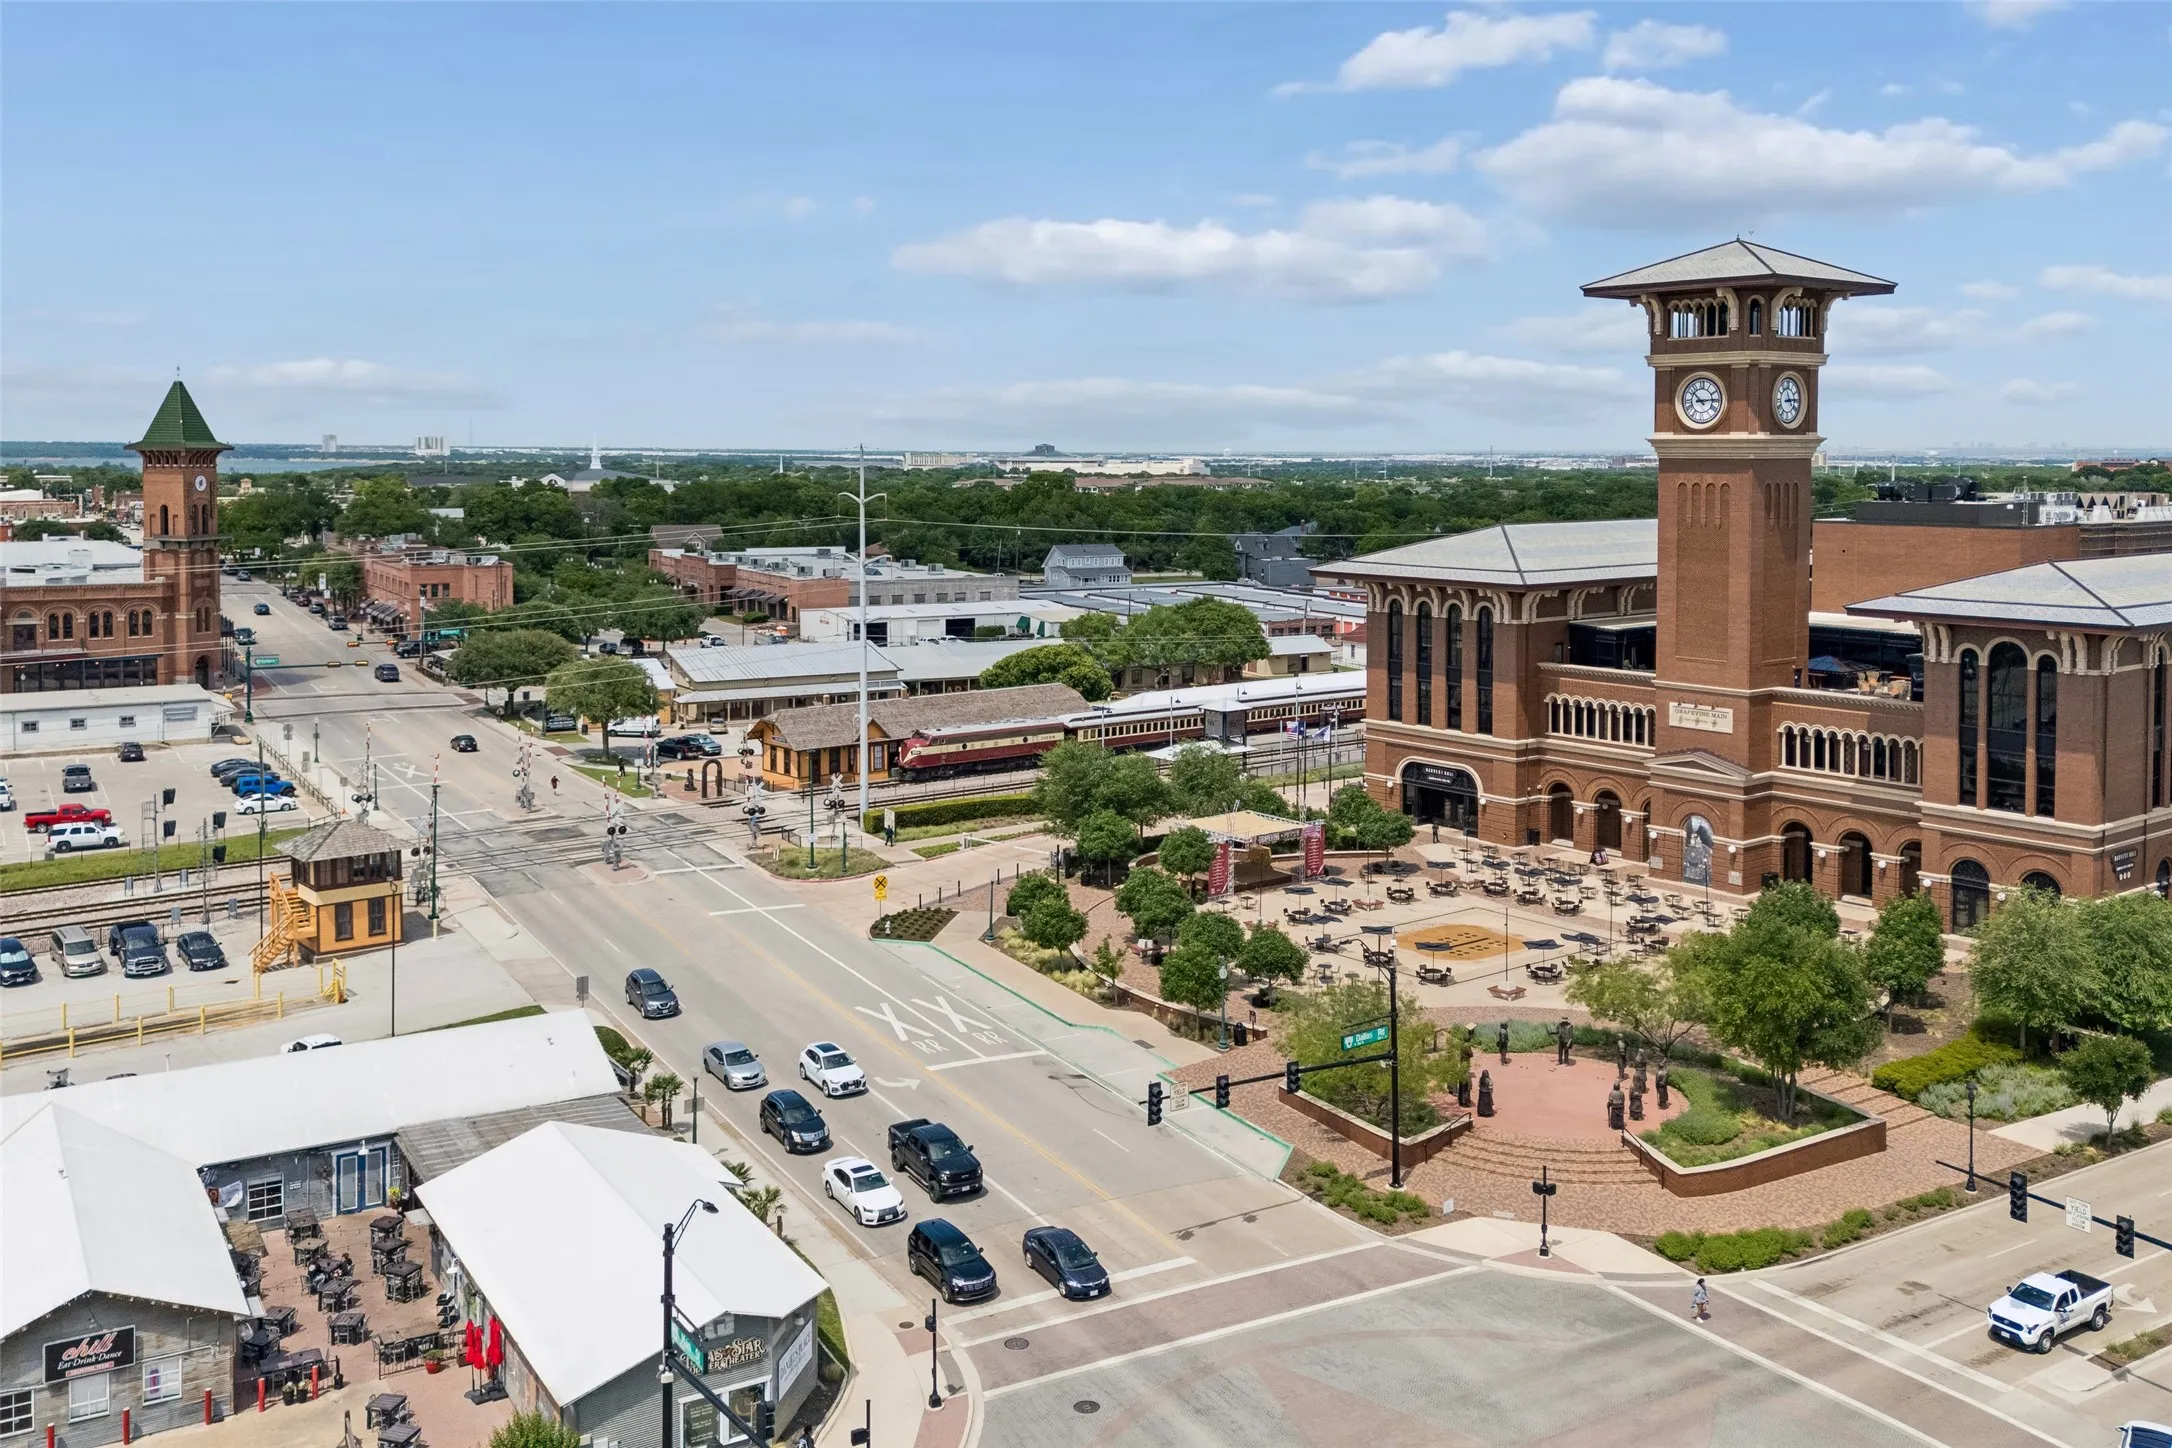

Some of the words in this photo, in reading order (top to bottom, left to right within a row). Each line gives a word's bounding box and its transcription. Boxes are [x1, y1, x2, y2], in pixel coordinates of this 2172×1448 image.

[1674, 709, 1710, 717] GRAPEVINE
[1356, 1032, 1373, 1042] Dallas
[1378, 1028, 1385, 1037] Rd
[2071, 1205, 2087, 1215] YIELD
[62, 1332, 118, 1361] chill
[721, 1350, 761, 1369] THEATER
